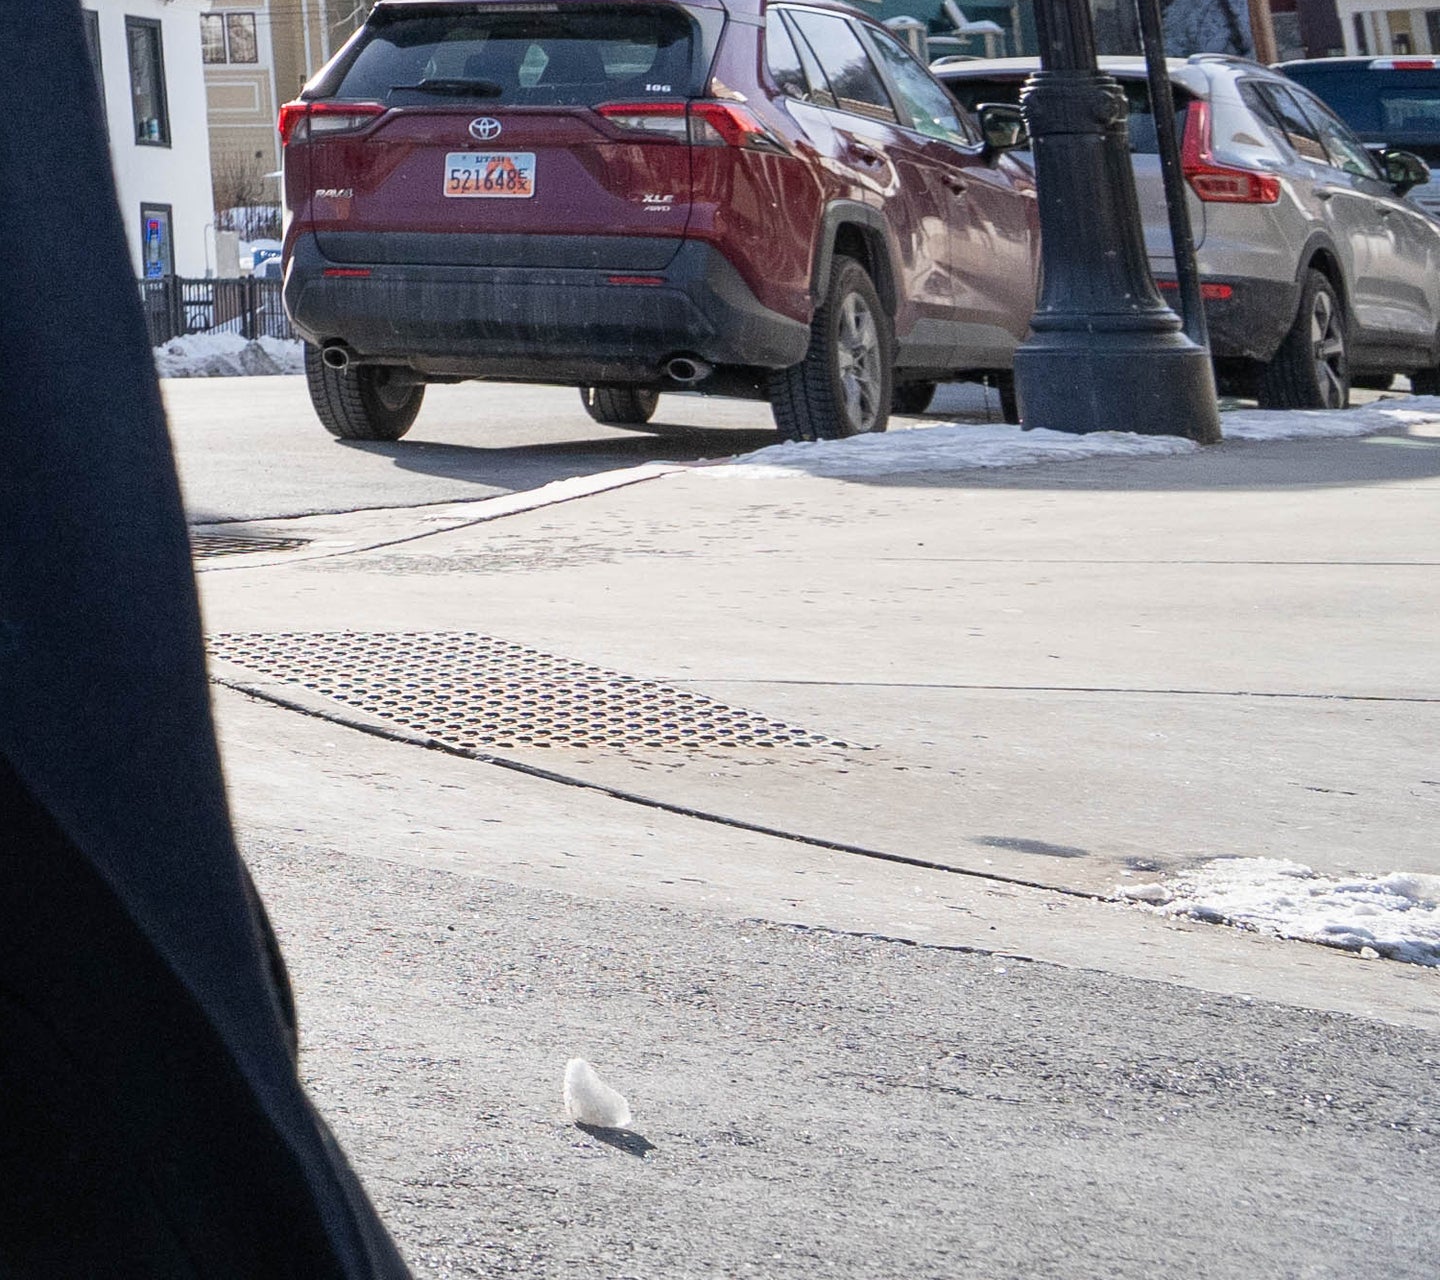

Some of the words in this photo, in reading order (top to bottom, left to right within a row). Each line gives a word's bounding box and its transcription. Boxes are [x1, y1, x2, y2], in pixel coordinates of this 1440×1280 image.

[475, 155, 505, 164] UTAH
[314, 188, 355, 198] RAV4
[642, 194, 674, 203] XLE
